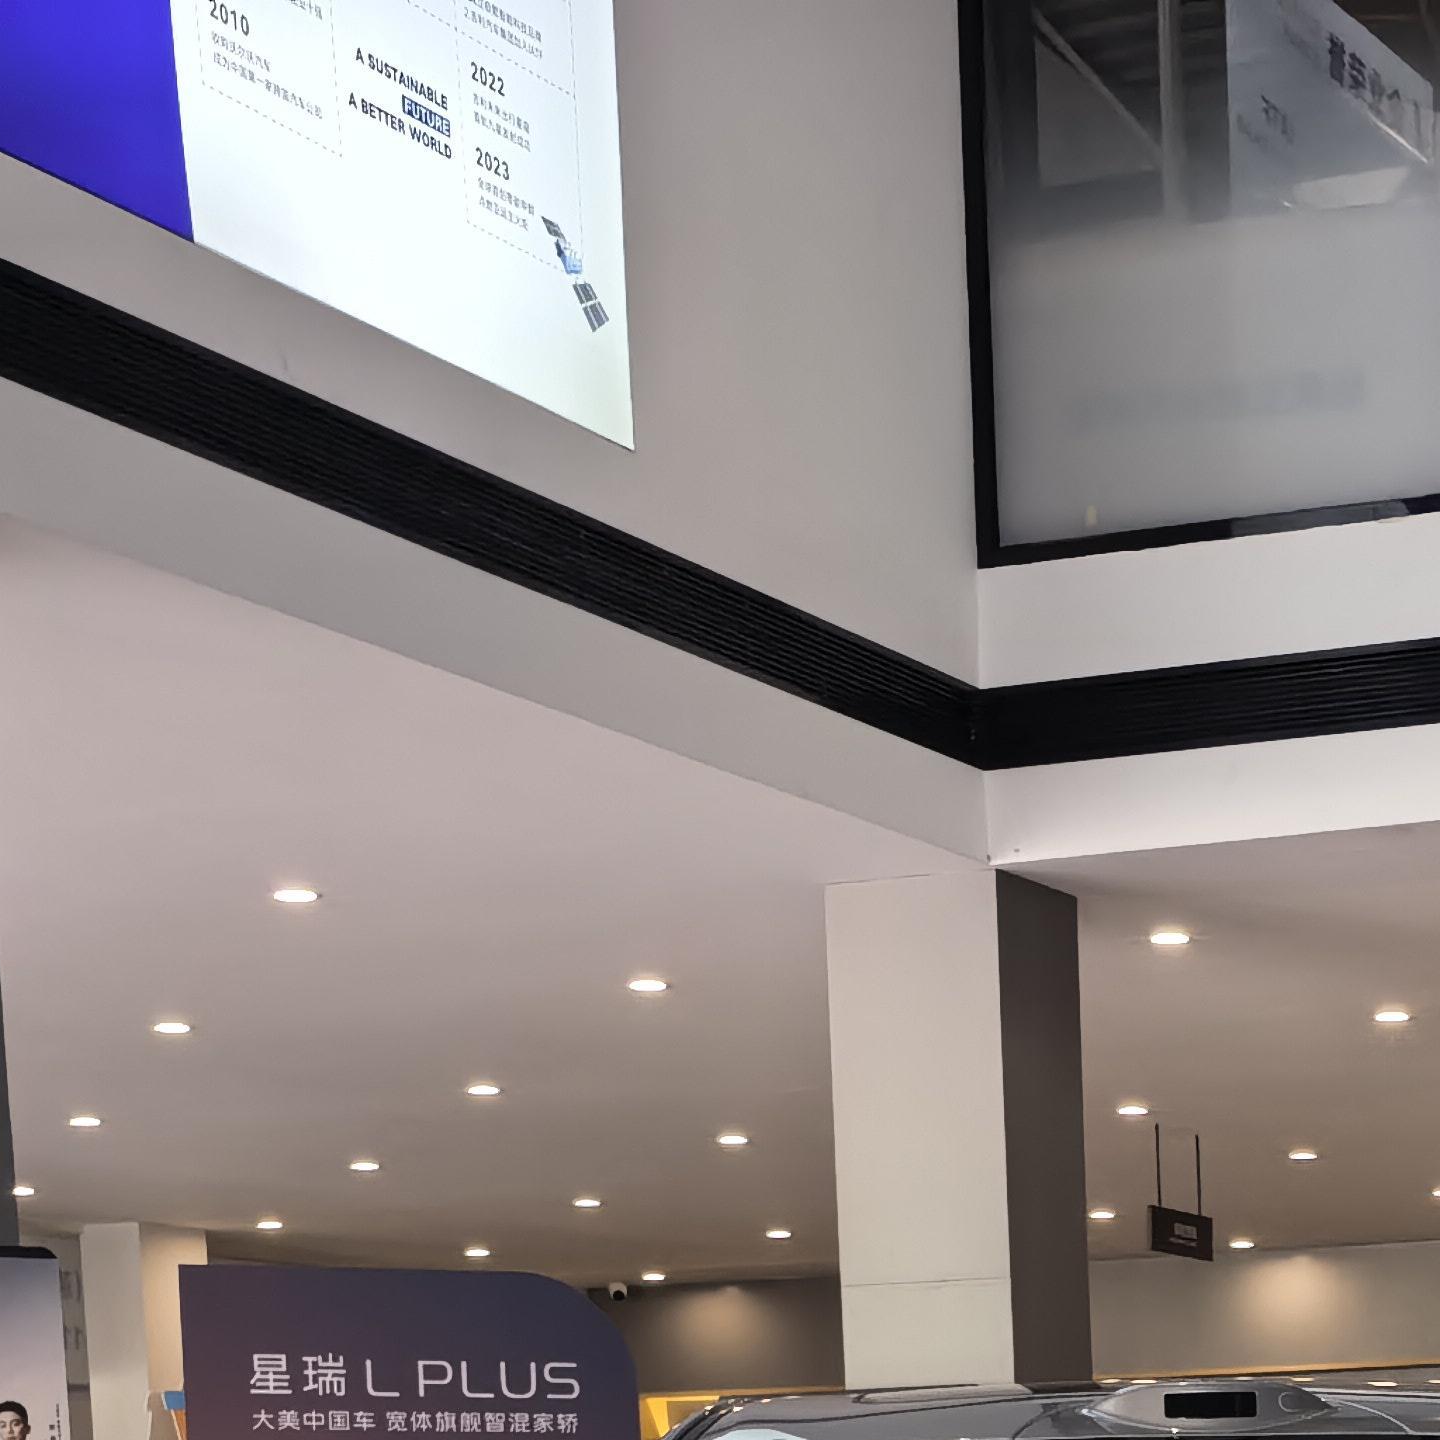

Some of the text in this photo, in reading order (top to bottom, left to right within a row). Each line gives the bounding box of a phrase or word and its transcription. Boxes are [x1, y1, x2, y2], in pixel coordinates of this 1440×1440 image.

[356, 47, 448, 111] A SUSTAINABLE
[471, 61, 505, 97] 2022
[348, 92, 452, 159] A BETTER WORLD
[402, 94, 451, 138] FUTURE
[475, 147, 510, 181] 2023
[418, 1358, 581, 1400] PLUS
[252, 1409, 579, 1435] 大美中国车 宽体旗舰智混家轿
